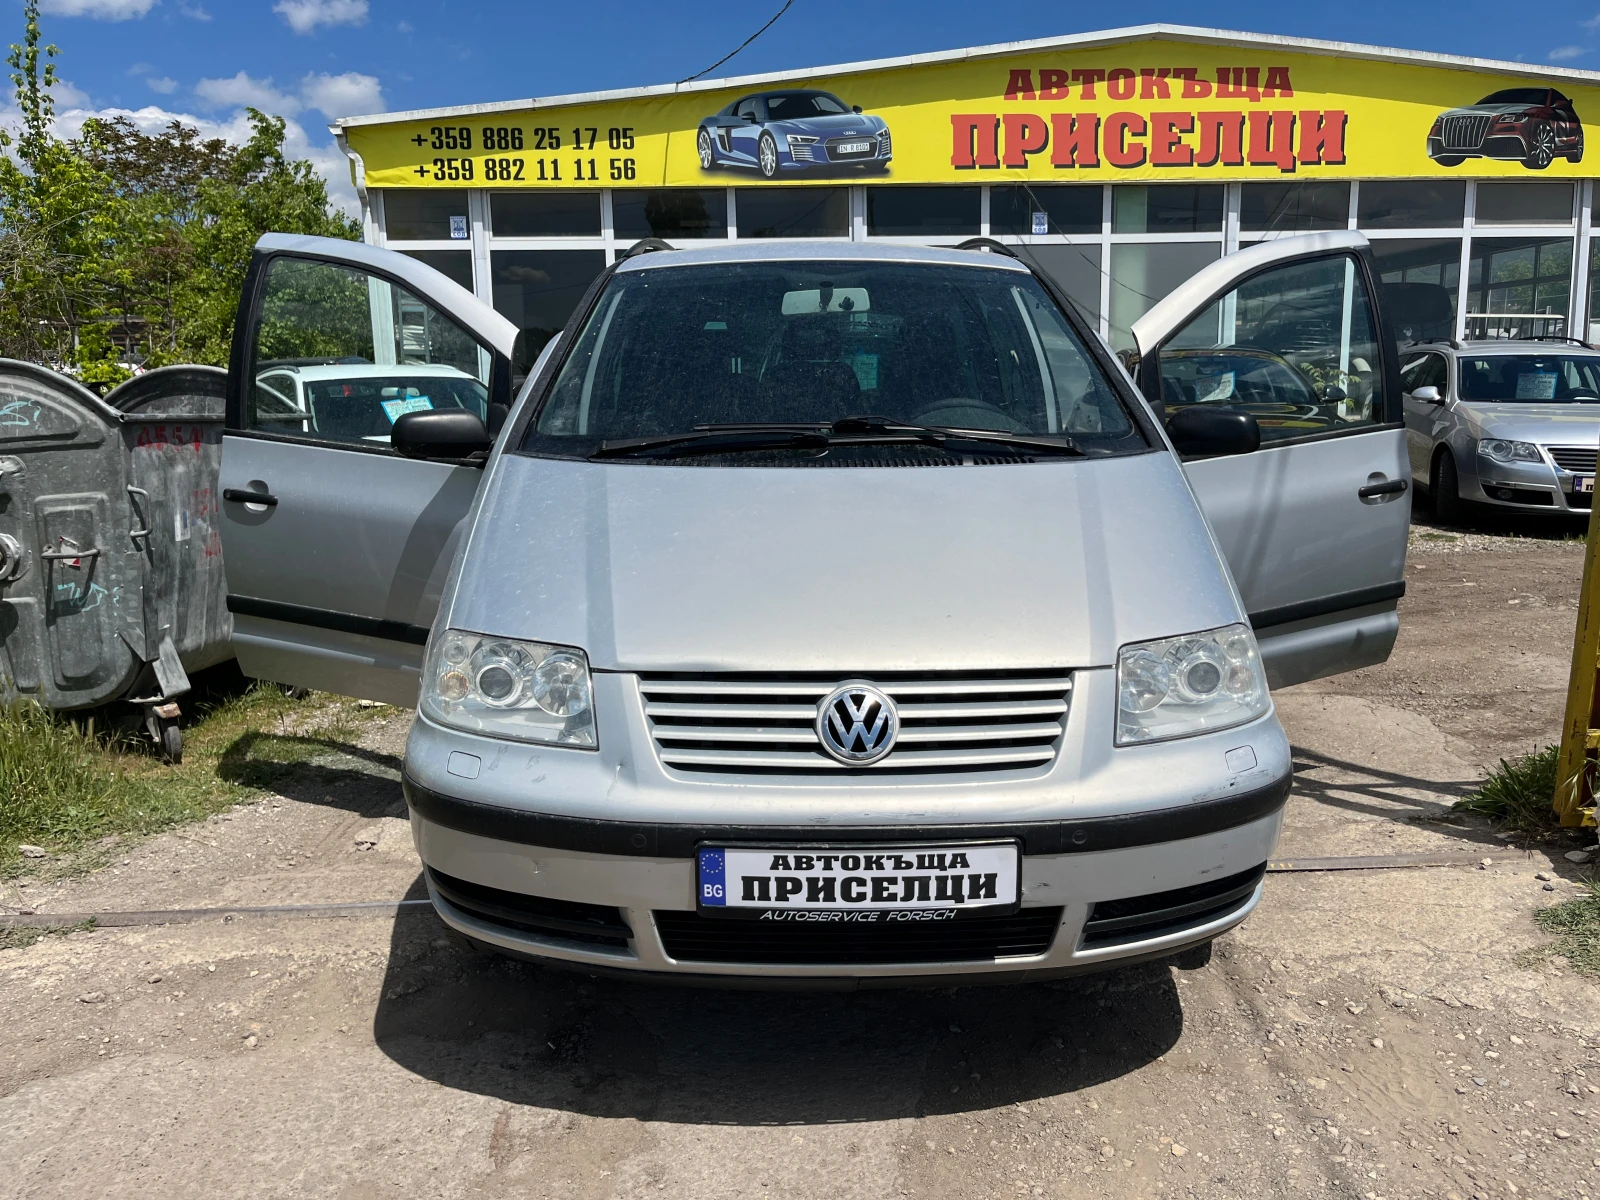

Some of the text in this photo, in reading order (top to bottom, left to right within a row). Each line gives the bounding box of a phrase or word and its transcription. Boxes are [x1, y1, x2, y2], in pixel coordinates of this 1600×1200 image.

[1003, 66, 1294, 102] АВТОКЪЩА
[411, 127, 635, 150] +359 886 25 17 05
[951, 110, 1349, 173] ПРИСЕЛЦИ
[413, 158, 636, 181] +359 882 11 11 56
[769, 852, 971, 872] АВТОКЪЩА
[704, 884, 723, 897] BG
[741, 872, 998, 904] ПРИСЕЛЦИ
[760, 909, 957, 922] AUTOSERVICE FORSCH
